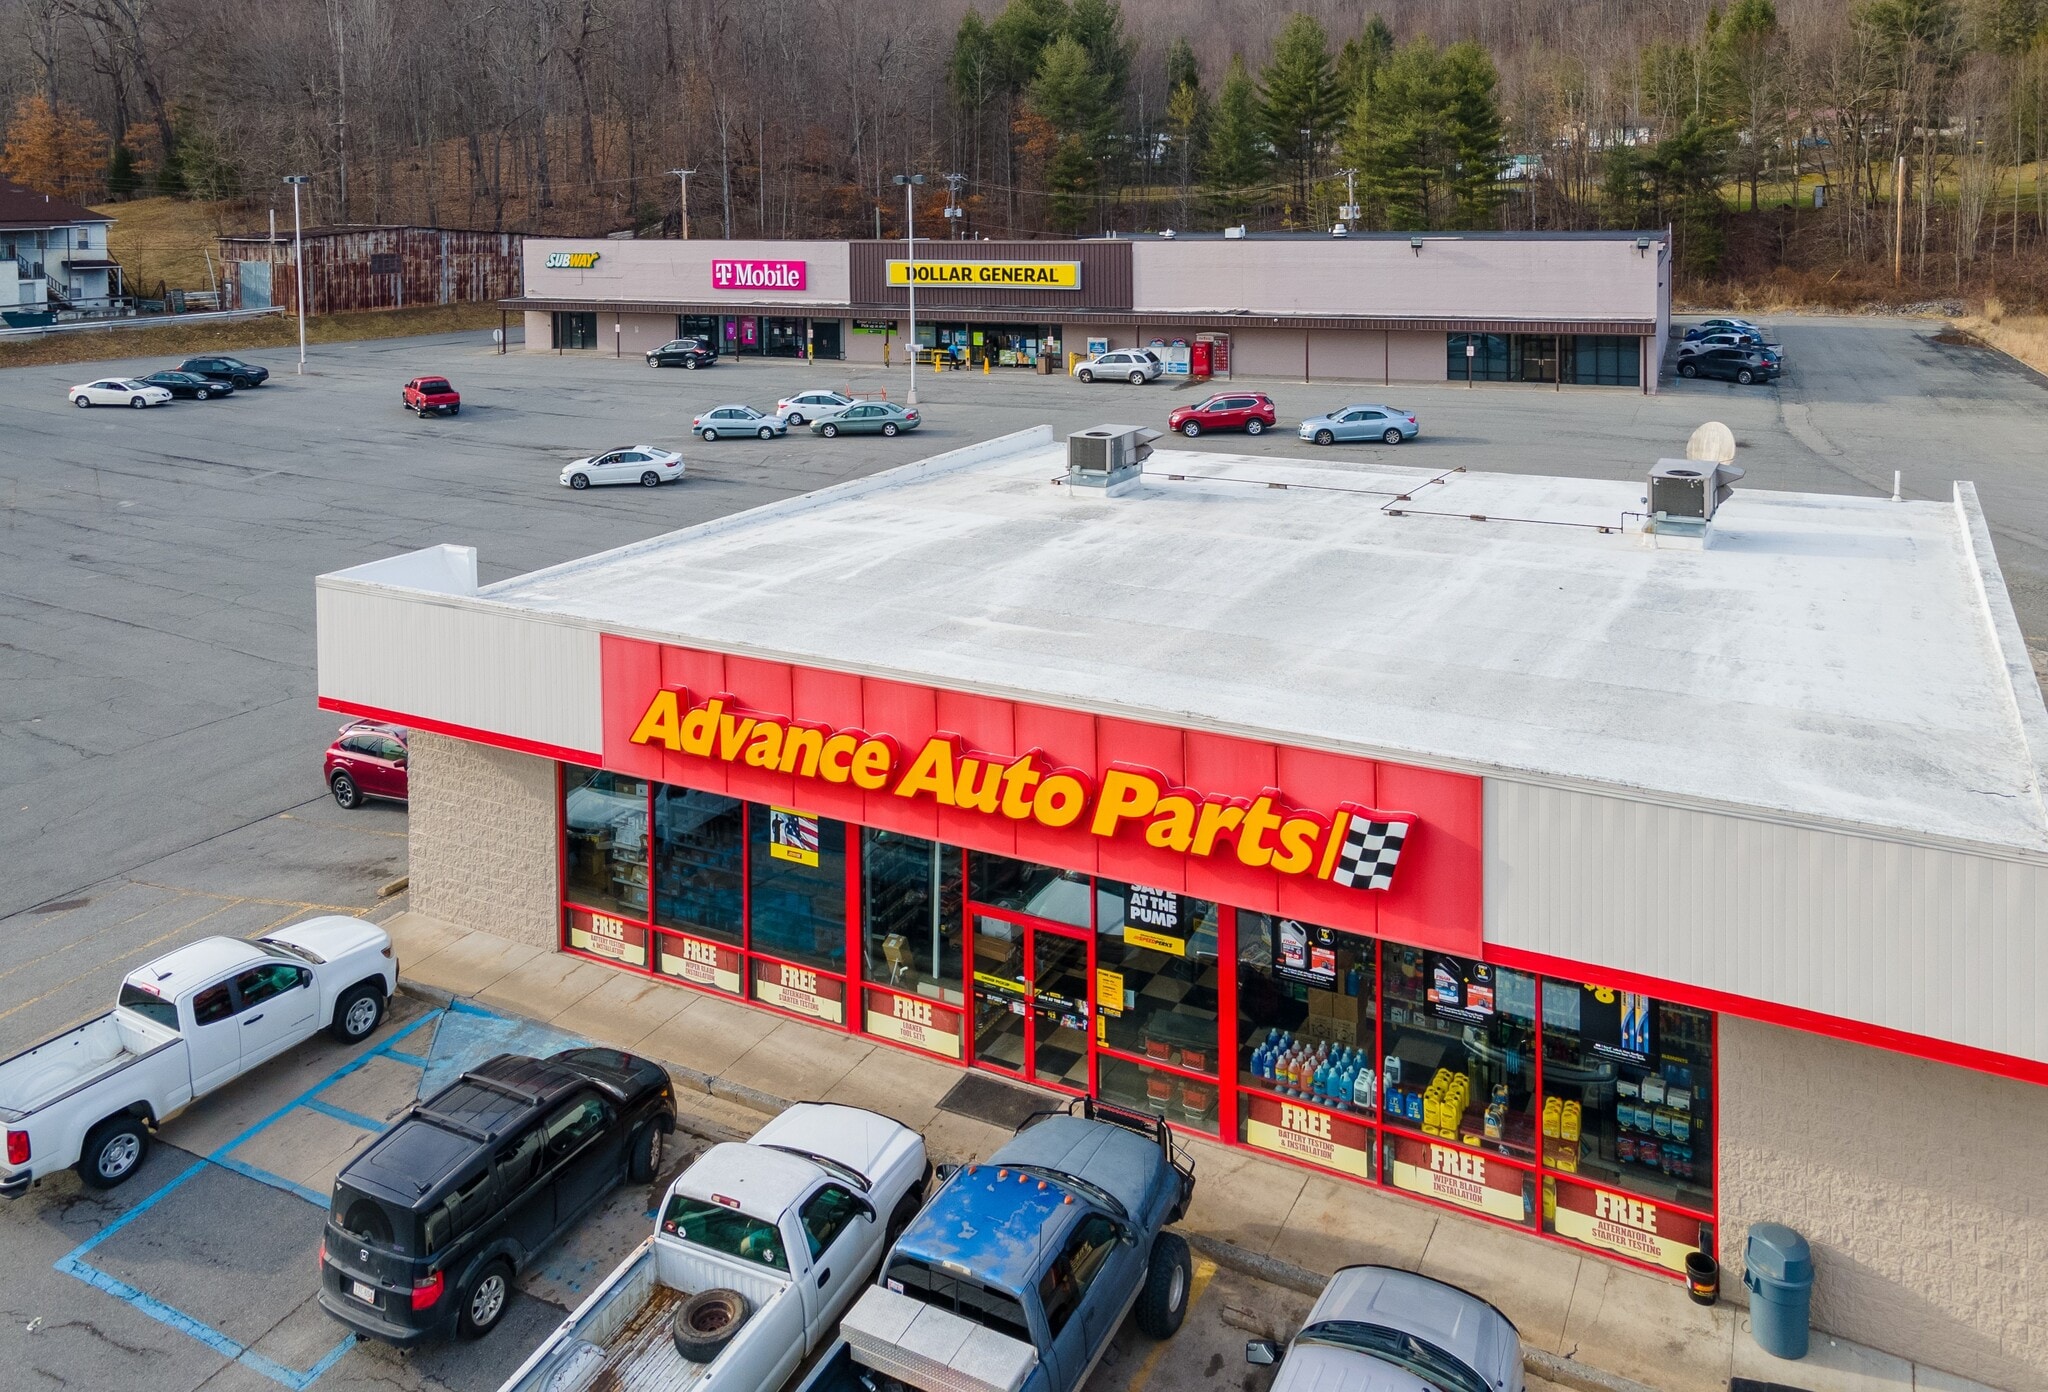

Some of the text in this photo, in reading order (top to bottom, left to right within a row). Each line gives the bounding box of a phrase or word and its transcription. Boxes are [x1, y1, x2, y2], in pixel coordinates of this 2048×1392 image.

[545, 252, 600, 268] SUBWAY
[735, 263, 800, 287] Mobile
[905, 266, 1059, 283] DOLLAR GENERAL
[630, 688, 1320, 874] Advance Auto Parts
[1130, 892, 1176, 914] AT THE
[592, 913, 624, 940] FREE
[1130, 906, 1178, 928] PUMP
[591, 934, 625, 950] BATTERY TESTING
[596, 942, 624, 954] INSTALLATION
[683, 938, 716, 966] FREE
[686, 962, 714, 974] WIPER BLADE
[686, 968, 715, 981] INSTALLATION
[780, 964, 816, 994] FREE
[779, 994, 819, 1011] STARTER TESTING
[782, 988, 810, 1002] ALTERNATOR
[893, 995, 932, 1026] FREE
[900, 1028, 926, 1042] TOOL SETS
[902, 1022, 922, 1034] LOANER
[1281, 1102, 1332, 1140] FREE
[1278, 1129, 1334, 1152] BATTERY TESTING
[1288, 1140, 1332, 1160] INSTALLATION
[1430, 1144, 1486, 1184] FREE
[1434, 1174, 1482, 1194] WIPER BLADE
[1434, 1182, 1483, 1204] INSTALLATION
[1595, 1190, 1657, 1234] FREE
[1592, 1228, 1662, 1256] STARTER TESTING
[1598, 1221, 1648, 1244] ALTERNATOR
